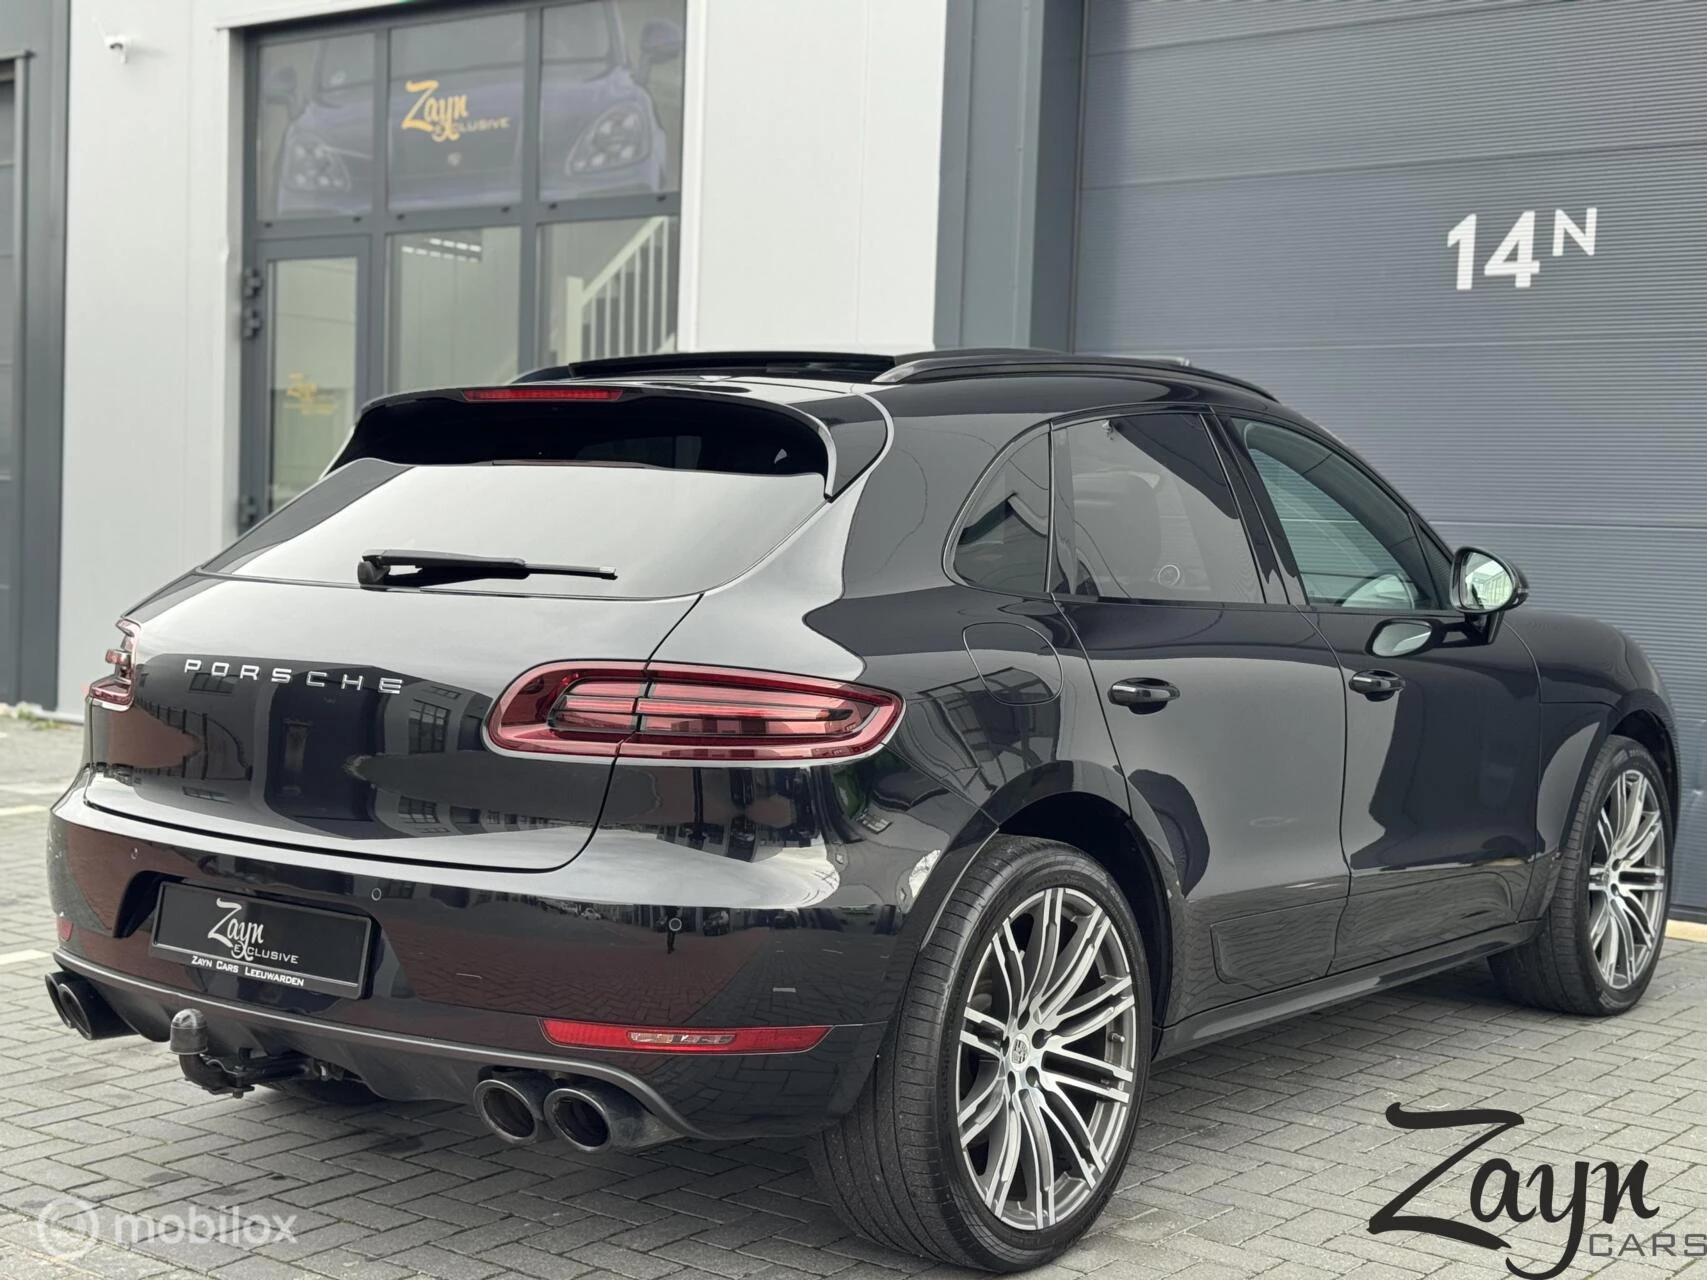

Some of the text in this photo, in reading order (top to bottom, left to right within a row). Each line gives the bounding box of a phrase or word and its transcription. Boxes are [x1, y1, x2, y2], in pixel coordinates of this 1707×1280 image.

[401, 80, 469, 141] Zayn
[184, 658, 404, 694] PORSCHE
[207, 897, 265, 960] Zayn
